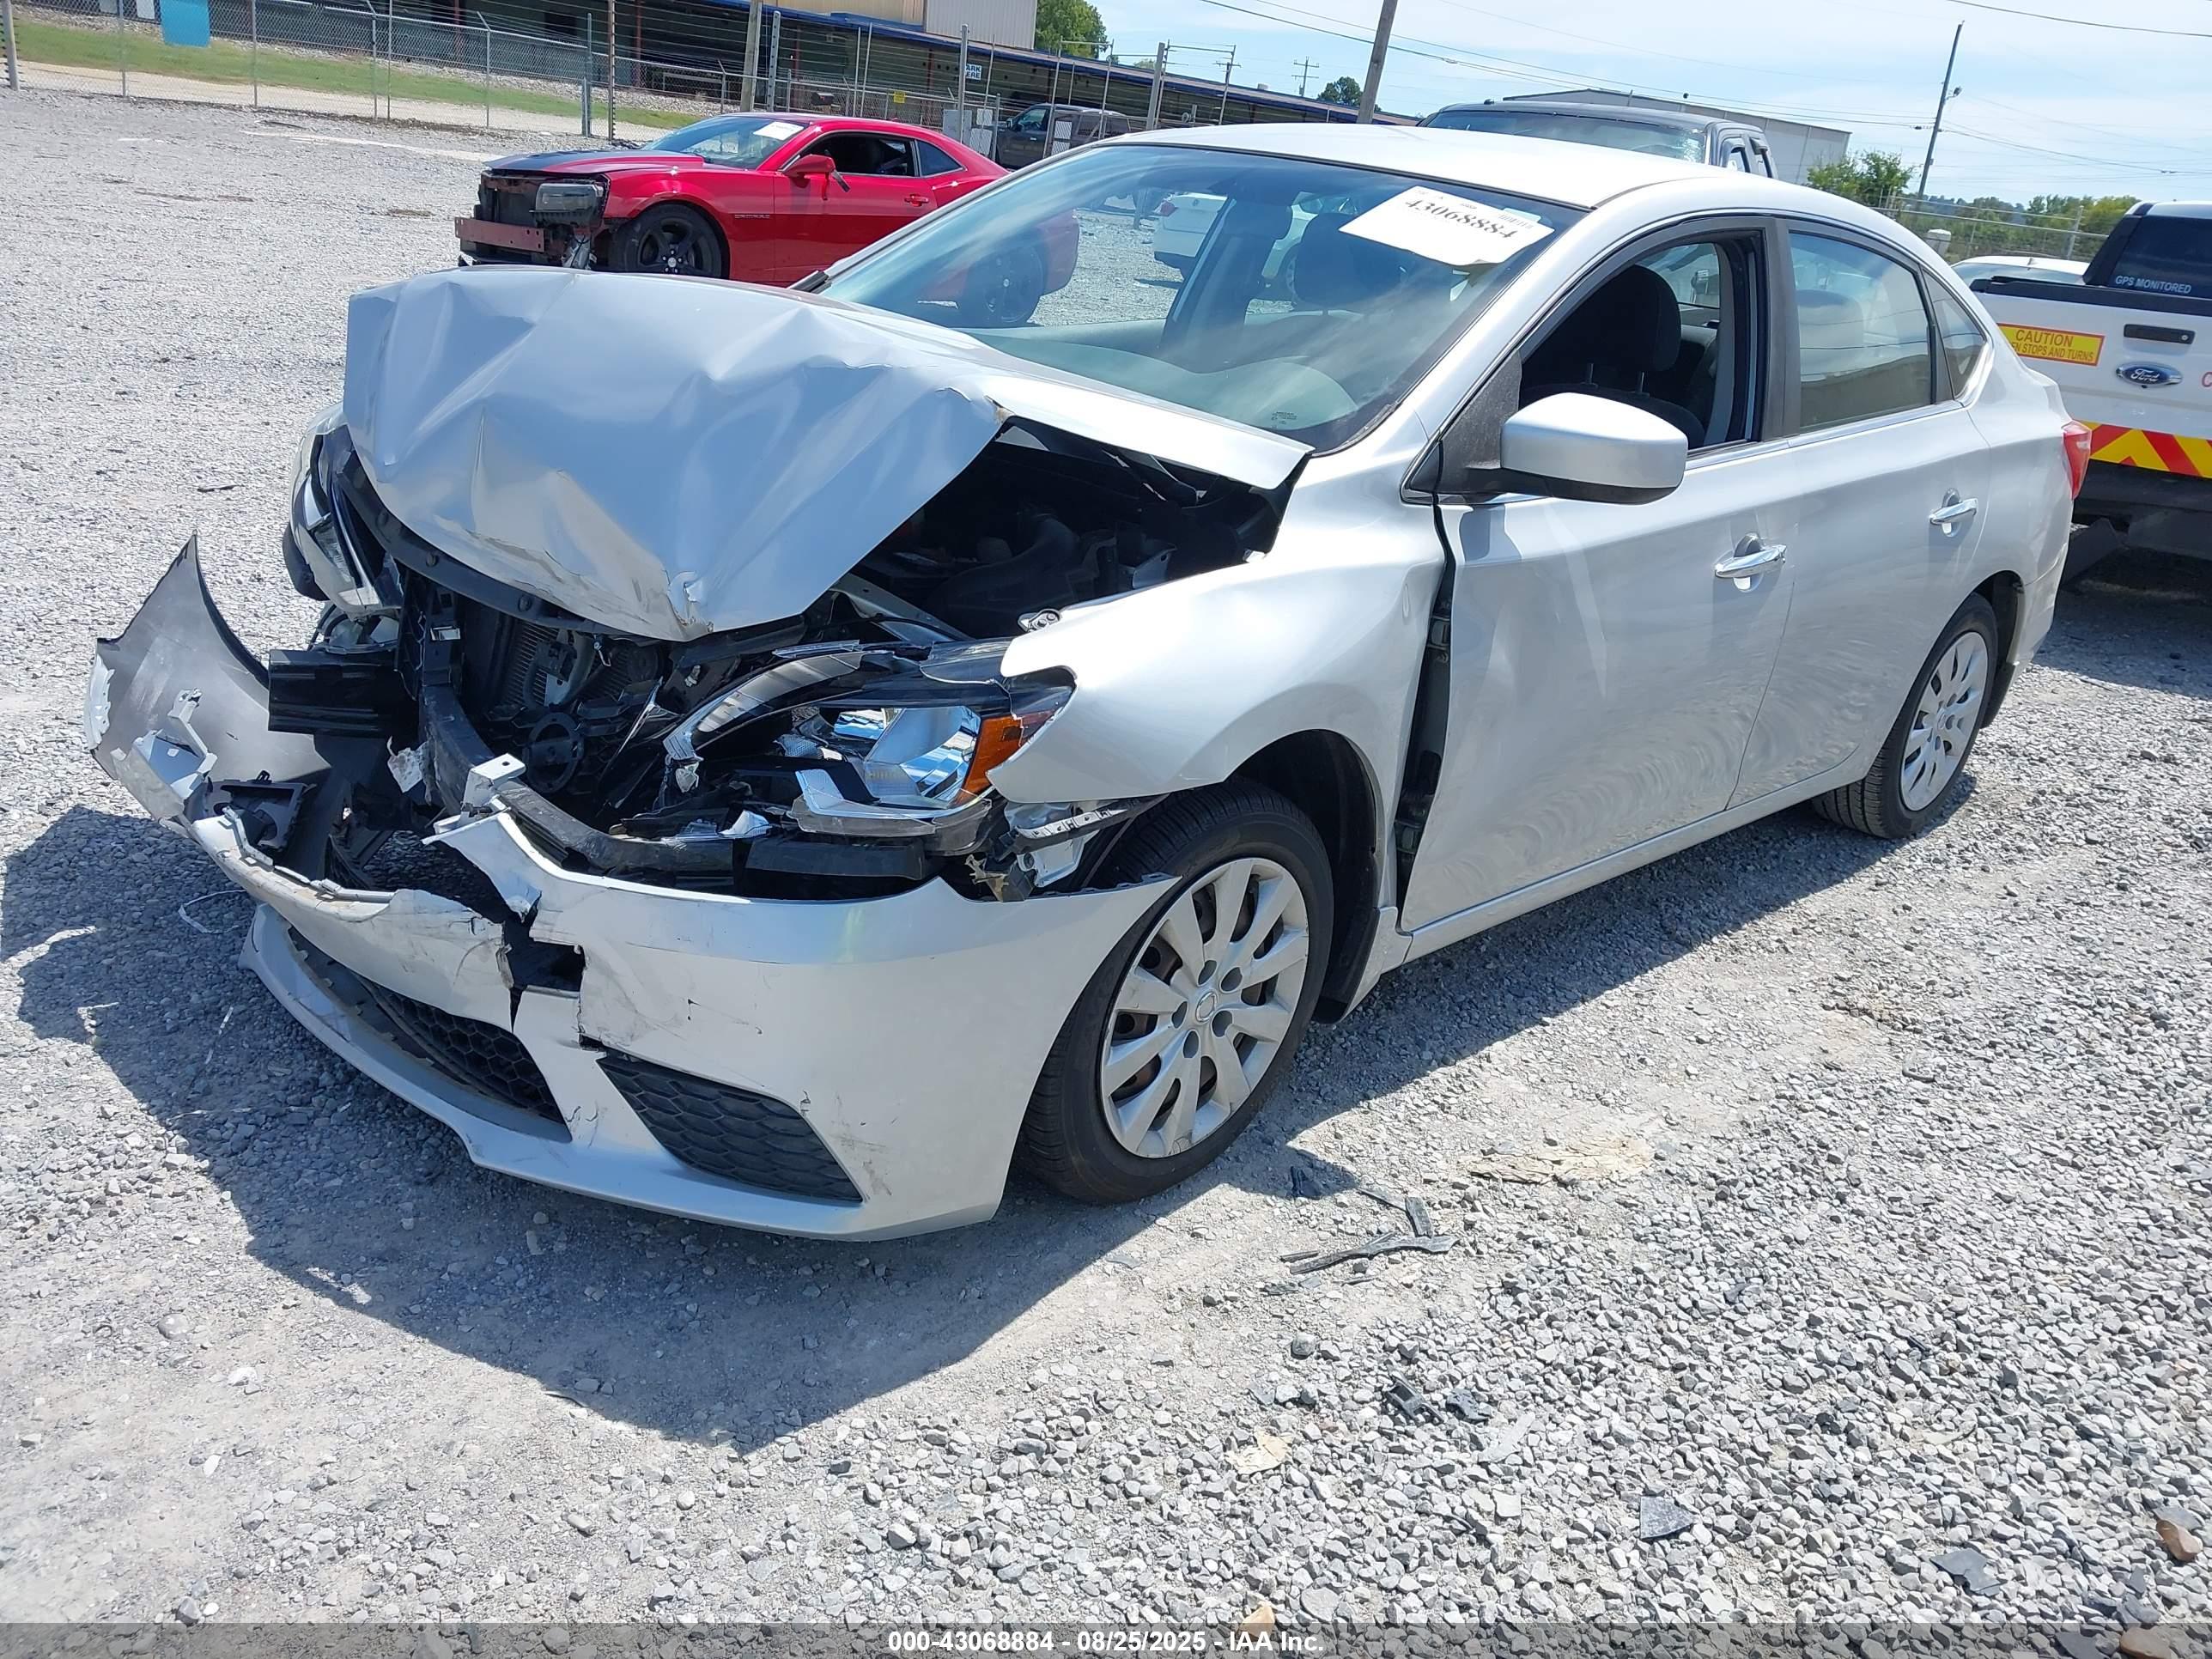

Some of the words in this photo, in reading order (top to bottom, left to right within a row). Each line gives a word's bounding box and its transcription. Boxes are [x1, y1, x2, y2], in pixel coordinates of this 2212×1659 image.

[1405, 199, 1518, 238] 43068884
[2115, 275, 2135, 286] GPS
[2136, 279, 2192, 294] MONITORED
[2015, 330, 2074, 347] CAUTION
[2022, 343, 2047, 356] STOPS
[2048, 346, 2066, 358] AND
[2068, 349, 2094, 362] TURNS
[2130, 368, 2160, 382] Ford
